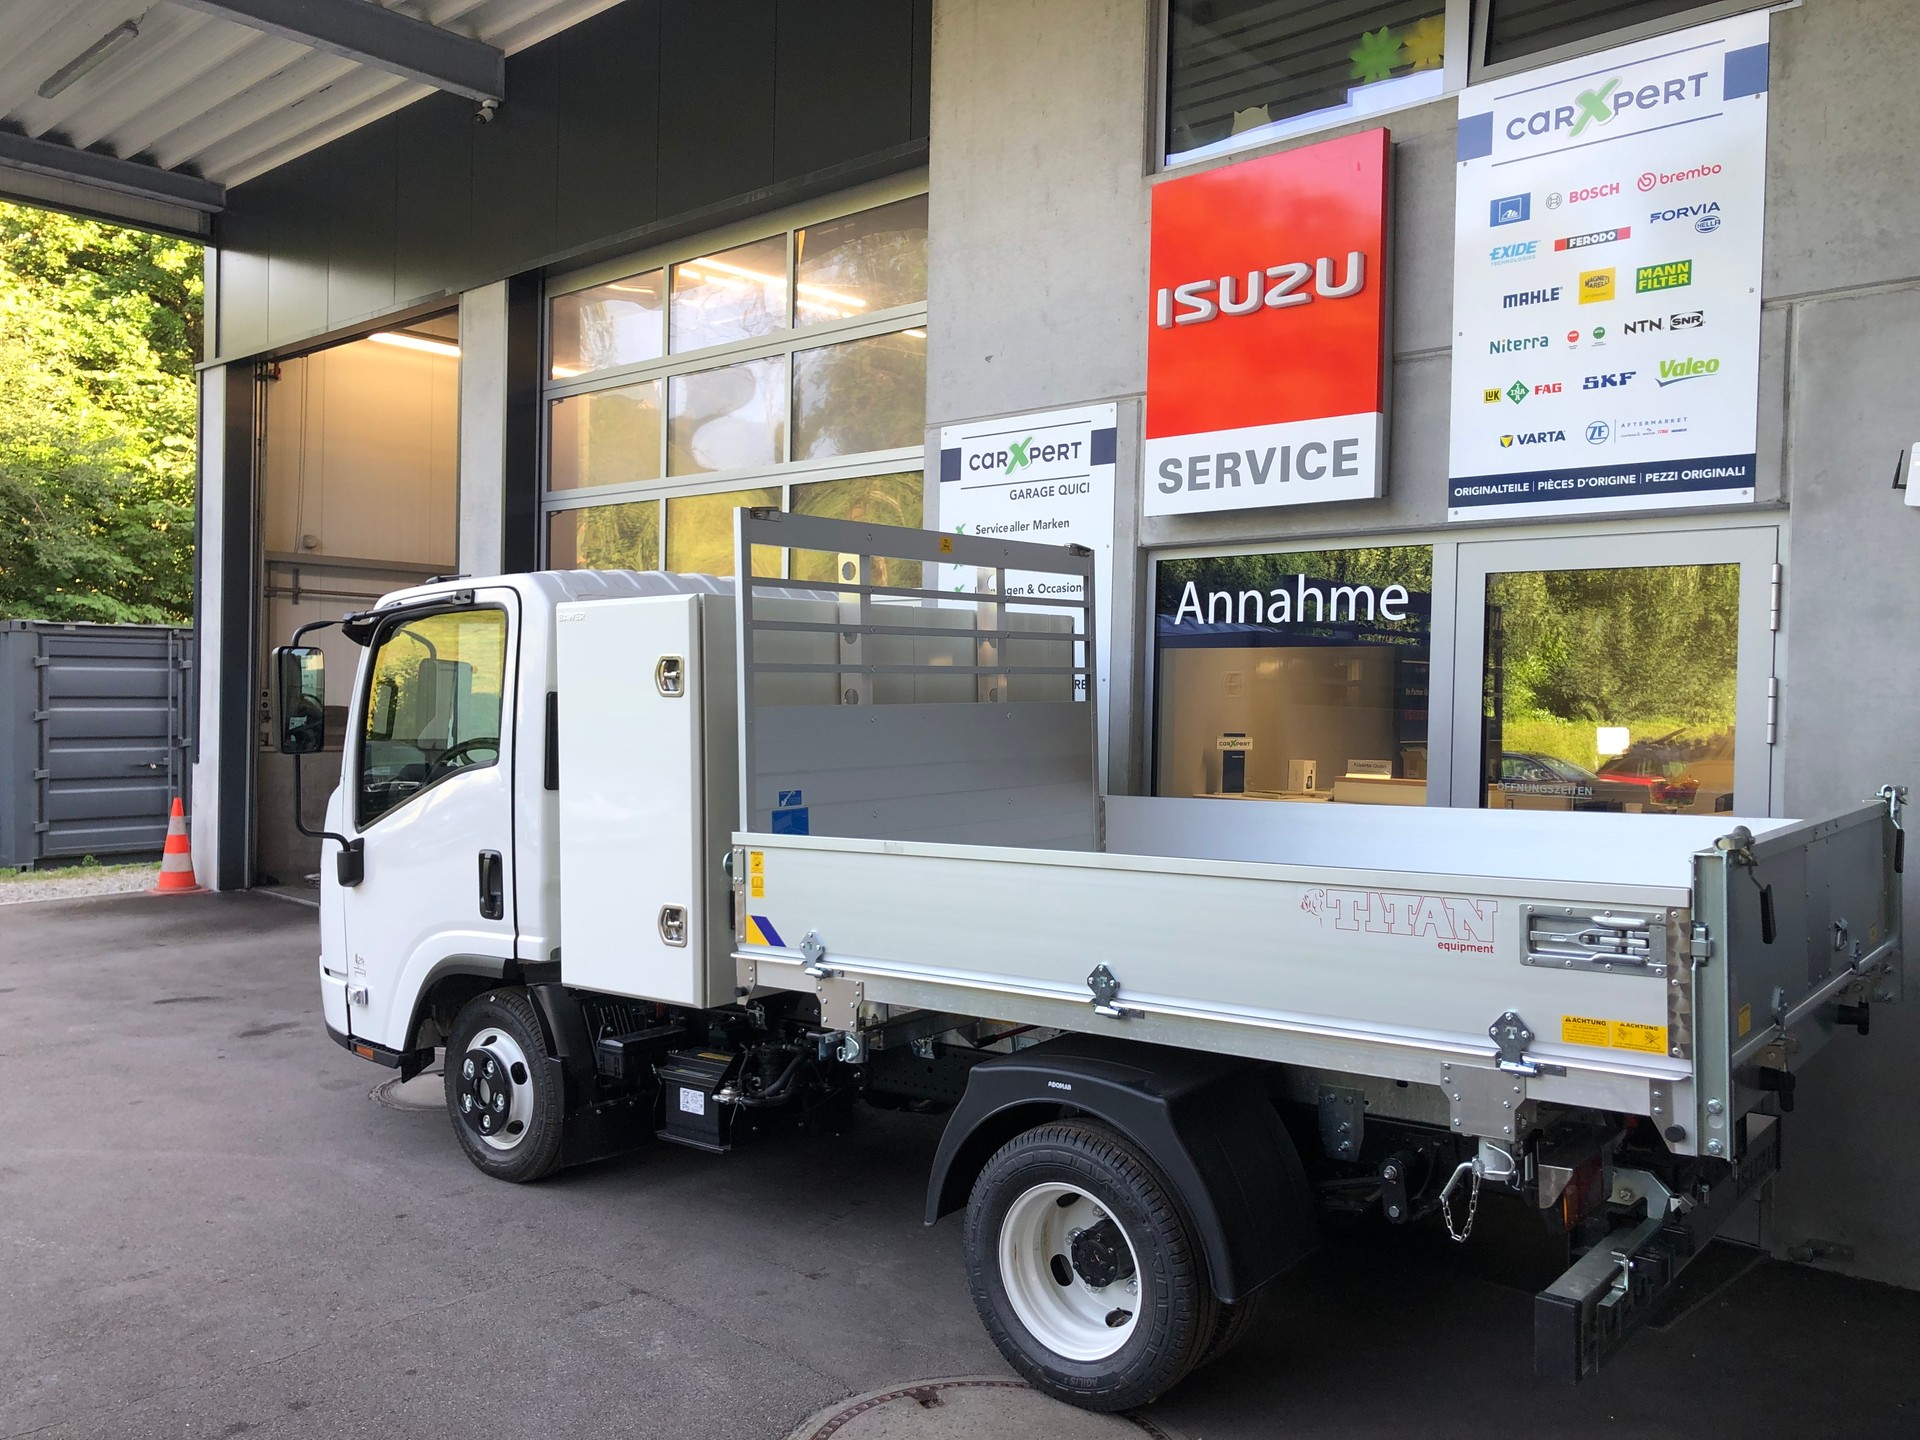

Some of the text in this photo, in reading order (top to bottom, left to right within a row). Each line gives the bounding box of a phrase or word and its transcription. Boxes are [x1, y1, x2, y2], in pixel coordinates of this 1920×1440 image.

[1660, 164, 1722, 185] brembo
[1569, 182, 1619, 203] BOSCH
[1650, 202, 1720, 223] FORVIA
[1569, 231, 1616, 247] FERODO
[1489, 241, 1538, 260] EXIDE
[1491, 255, 1536, 266] TECHNOLOGIES
[1640, 262, 1688, 279] MANN
[1156, 251, 1365, 328] ISUZU
[1639, 274, 1688, 290] FILTER
[1503, 287, 1560, 308] MAHLE
[1624, 315, 1701, 335] NTN SNR
[1490, 336, 1549, 354] Niterra
[1660, 357, 1720, 379] Valeo
[1535, 383, 1562, 395] FAG
[1583, 371, 1636, 390] SKF
[1621, 417, 1687, 428] AFTERMARKET
[1517, 430, 1566, 445] VARTA
[1158, 438, 1359, 494] SERVICE
[1454, 482, 1530, 497] ORIGINALTEILE
[1538, 479, 1574, 491] PIÈCES
[1645, 471, 1678, 482] PEZZI
[1681, 466, 1746, 480] ORIGINALI
[1009, 482, 1090, 500] GARAGE QUICI
[975, 518, 1070, 535] Service aller Marken
[1027, 584, 1035, 594] &
[1174, 574, 1409, 625] Annahme
[1497, 780, 1593, 796] ÖFFNUNGSZEITEN
[1326, 889, 1498, 943] TITAN
[1438, 941, 1494, 954] equipment
[1572, 1017, 1607, 1027] ACHTUNG
[1626, 1023, 1659, 1031] ACHTUNG
